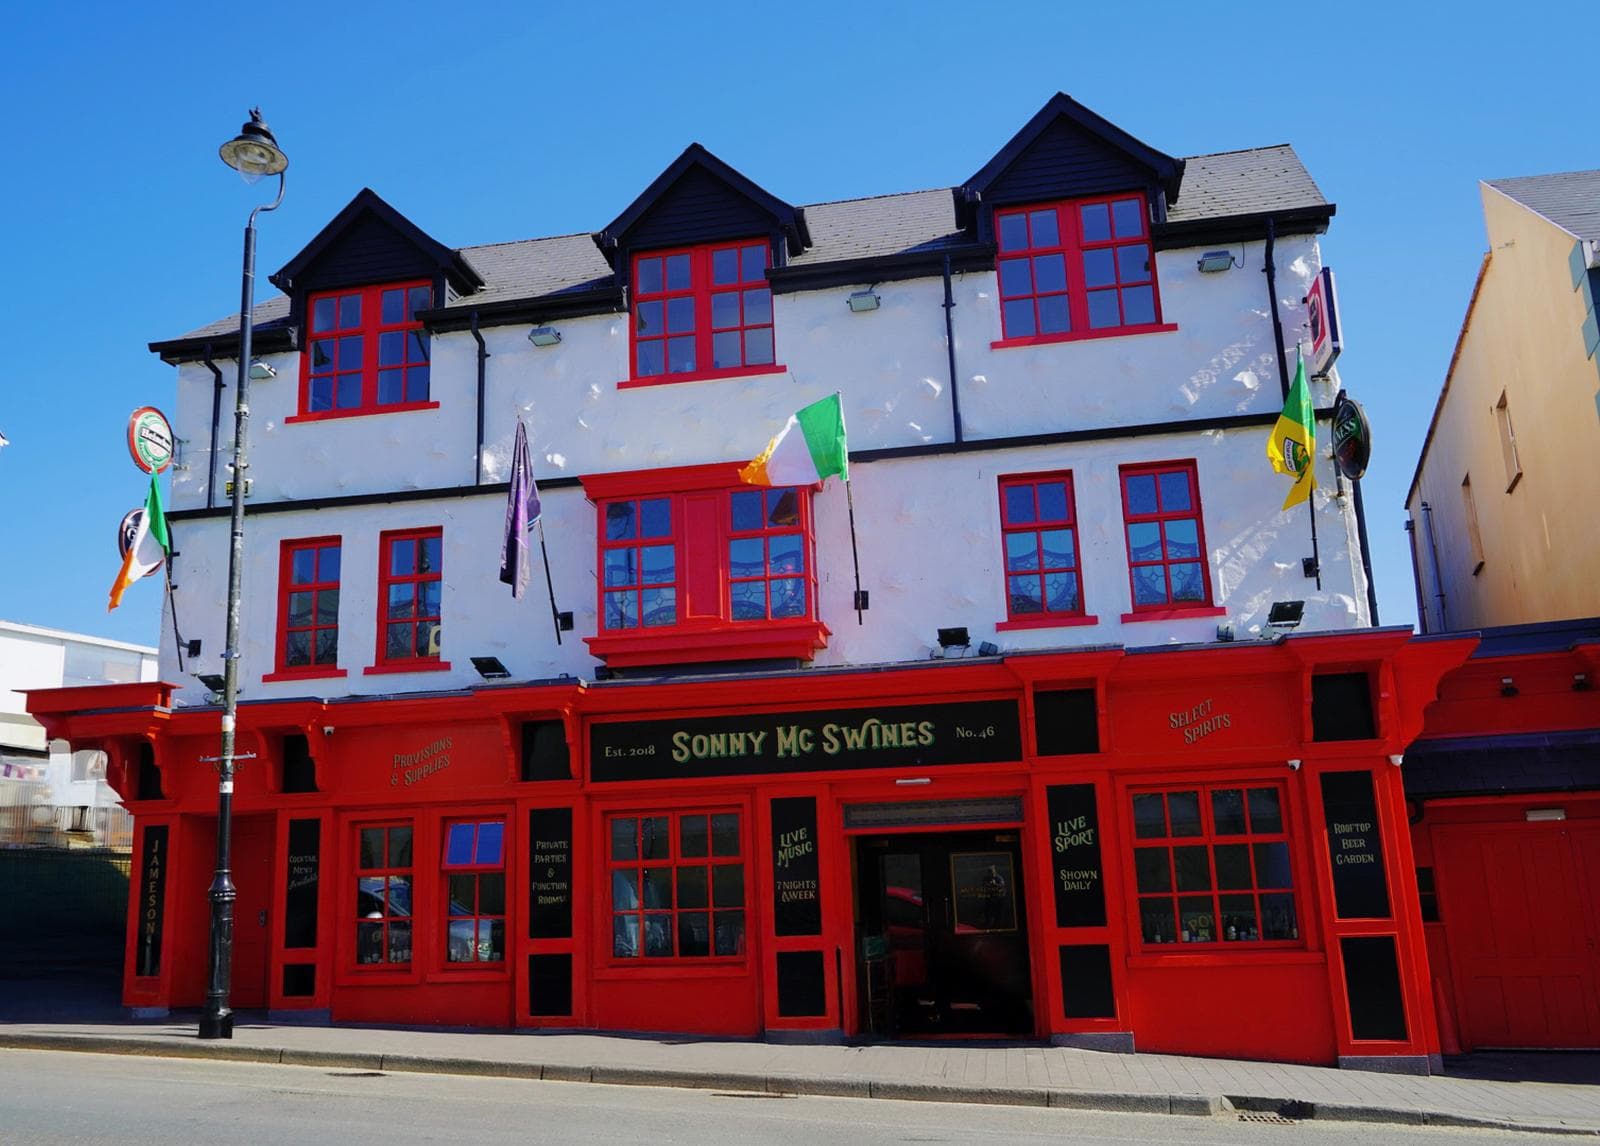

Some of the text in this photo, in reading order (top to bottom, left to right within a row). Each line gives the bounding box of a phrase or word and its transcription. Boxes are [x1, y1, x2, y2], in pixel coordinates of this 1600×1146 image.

[1169, 698, 1213, 729] SELECT
[1184, 713, 1231, 744] SPIRITS
[672, 731, 768, 763] SONNY
[822, 718, 935, 754] SWINES
[393, 737, 452, 769] PROVISIONS
[605, 744, 656, 758] Est. 2018
[391, 754, 450, 786] & SUPPLIES
[1058, 816, 1087, 836] LIVE
[1334, 823, 1371, 834] ROOFTOP
[536, 840, 568, 850] PRIVATE
[780, 827, 807, 848] LIVE
[1055, 829, 1094, 853] SPORT
[1342, 838, 1366, 849] BEER
[534, 854, 567, 864] PARTIES
[777, 841, 813, 868] MUSIC
[1336, 854, 1375, 865] GARDEN
[547, 867, 556, 878] &
[1060, 869, 1098, 881] SHOWN
[146, 840, 159, 934] JAMESON
[532, 882, 567, 892] FUNCTION
[1064, 881, 1092, 891] DAILY
